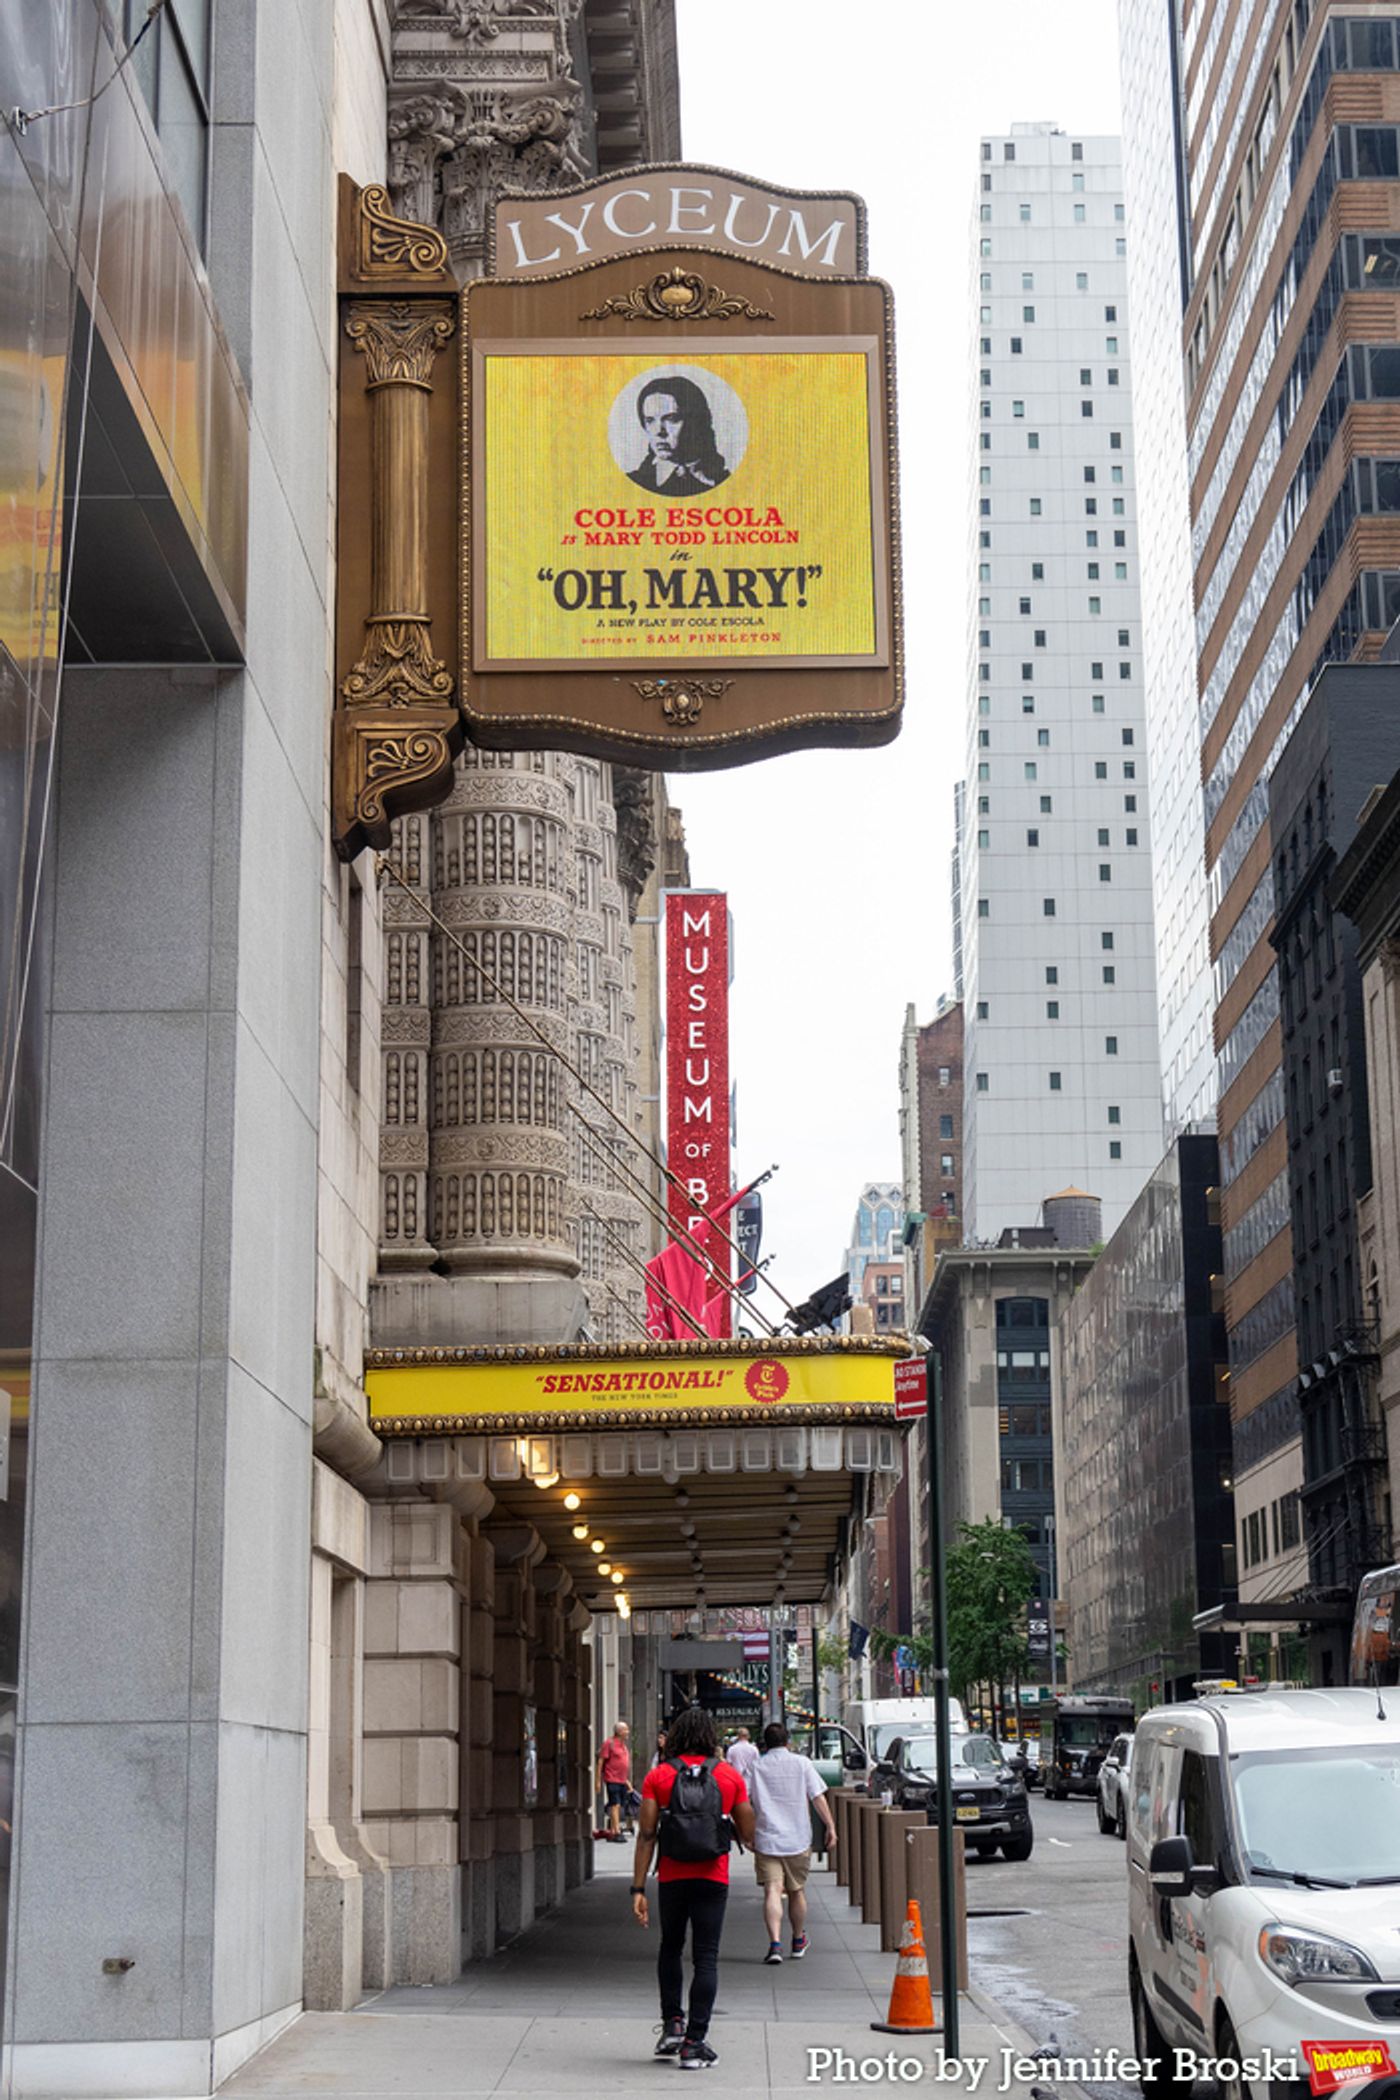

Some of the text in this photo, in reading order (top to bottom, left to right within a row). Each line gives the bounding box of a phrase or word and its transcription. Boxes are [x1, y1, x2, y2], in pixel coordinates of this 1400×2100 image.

[506, 187, 846, 267] LYCEUM
[574, 507, 784, 528] COLE ESCOLA
[584, 532, 642, 546] MARY
[651, 531, 706, 545] TODD
[712, 530, 799, 545] LINCOLN
[669, 549, 693, 561] in
[609, 618, 636, 628] NEW
[638, 618, 667, 628] PLAY
[671, 618, 685, 627] BY
[688, 617, 717, 627] COLE
[721, 616, 765, 626] ESCOLA
[646, 633, 680, 645] SAM
[689, 631, 781, 644] PINKLETON
[682, 910, 712, 1124] MUSEUM
[685, 1143, 713, 1158] OF
